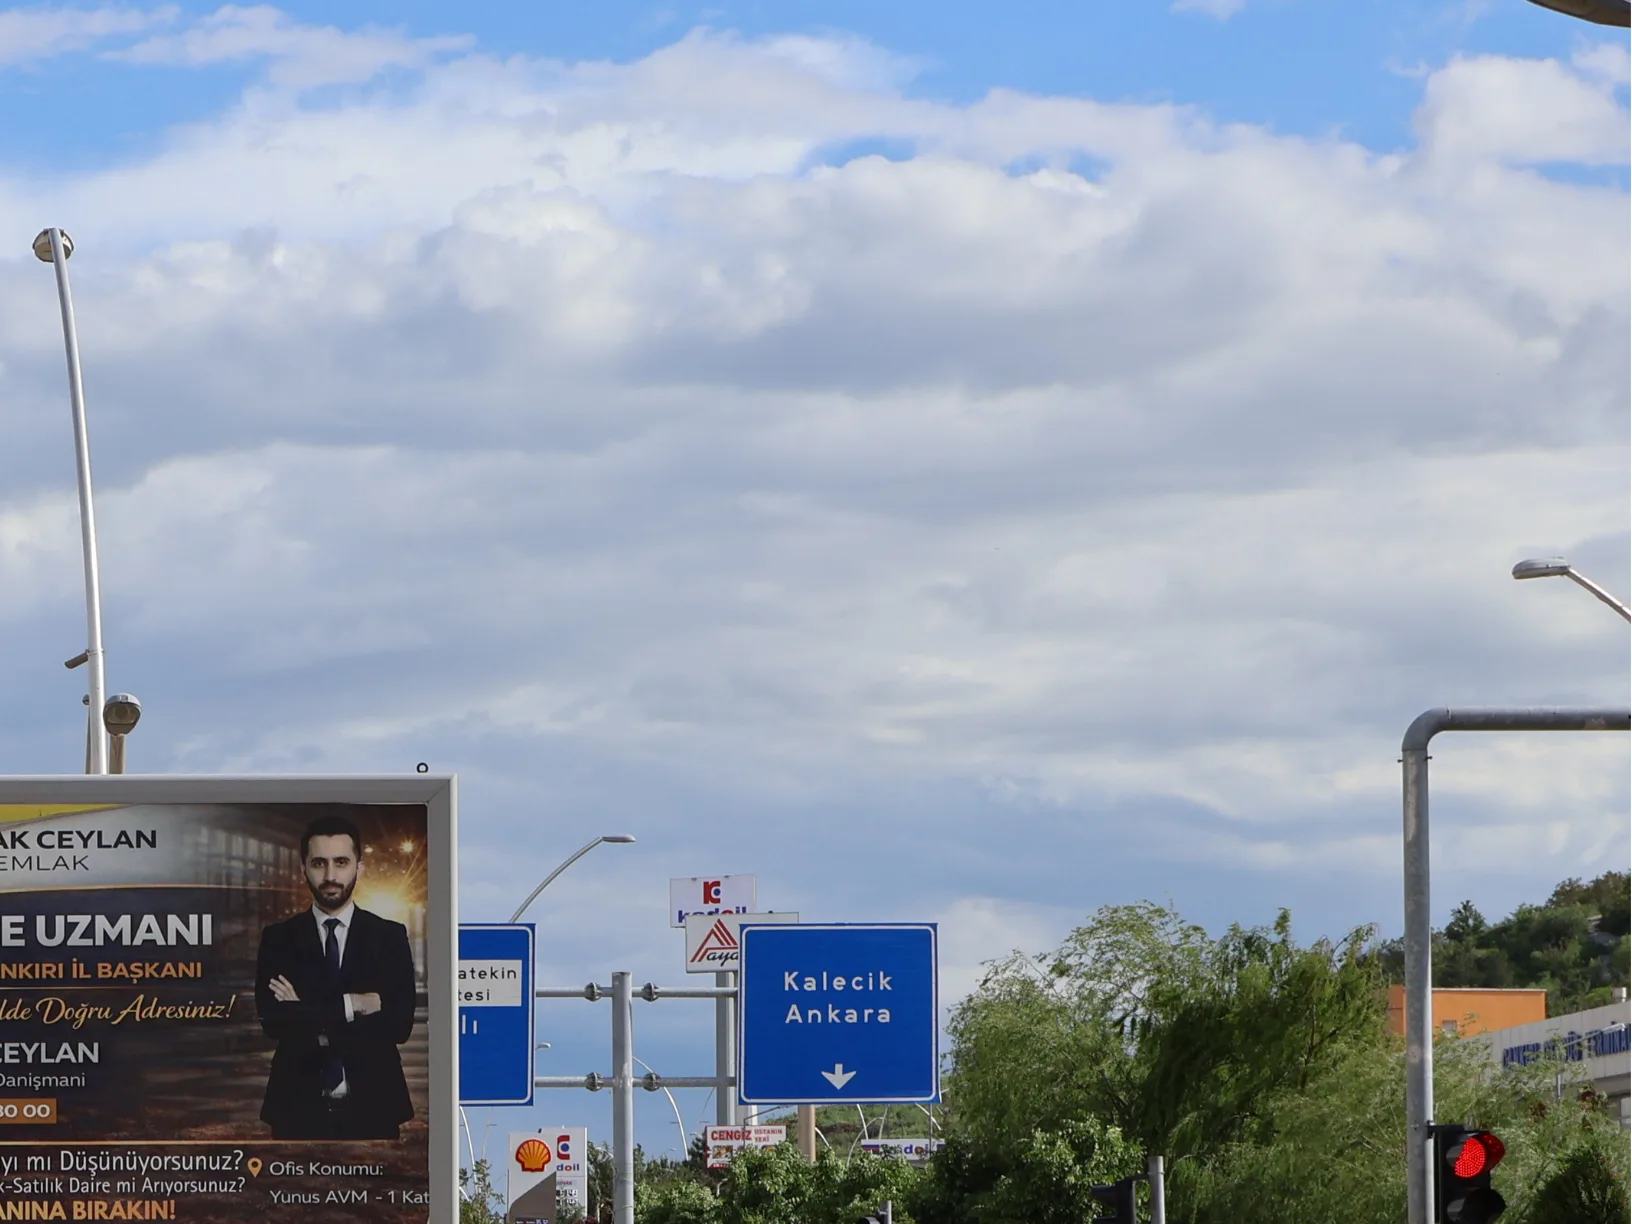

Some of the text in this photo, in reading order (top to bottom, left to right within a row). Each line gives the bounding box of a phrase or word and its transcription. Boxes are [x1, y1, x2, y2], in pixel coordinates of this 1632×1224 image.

[36, 829, 157, 850] CEYLAN
[36, 913, 213, 947] UZMANI
[71, 957, 92, 980] İL
[97, 961, 203, 984] BAŞKANI
[458, 966, 517, 980] atekin
[784, 971, 893, 991] Kalecik
[35, 997, 113, 1029] Doğru
[110, 994, 237, 1025] Adresiniz!
[785, 1004, 891, 1024] Ankara
[23, 1104, 51, 1118] 00
[27, 1155, 51, 1172] mı
[60, 1150, 244, 1177] Düşünüyorsunuz?
[269, 1161, 384, 1176] Ofis Konumu:
[69, 1177, 111, 1193] Daire
[116, 1177, 136, 1193] mi
[142, 1177, 246, 1197] Arıyorsunuz?
[269, 1190, 320, 1204] Yunus
[325, 1190, 368, 1204] AVM
[402, 1190, 430, 1204] Kat
[72, 1200, 177, 1221] BIRAKIN!
